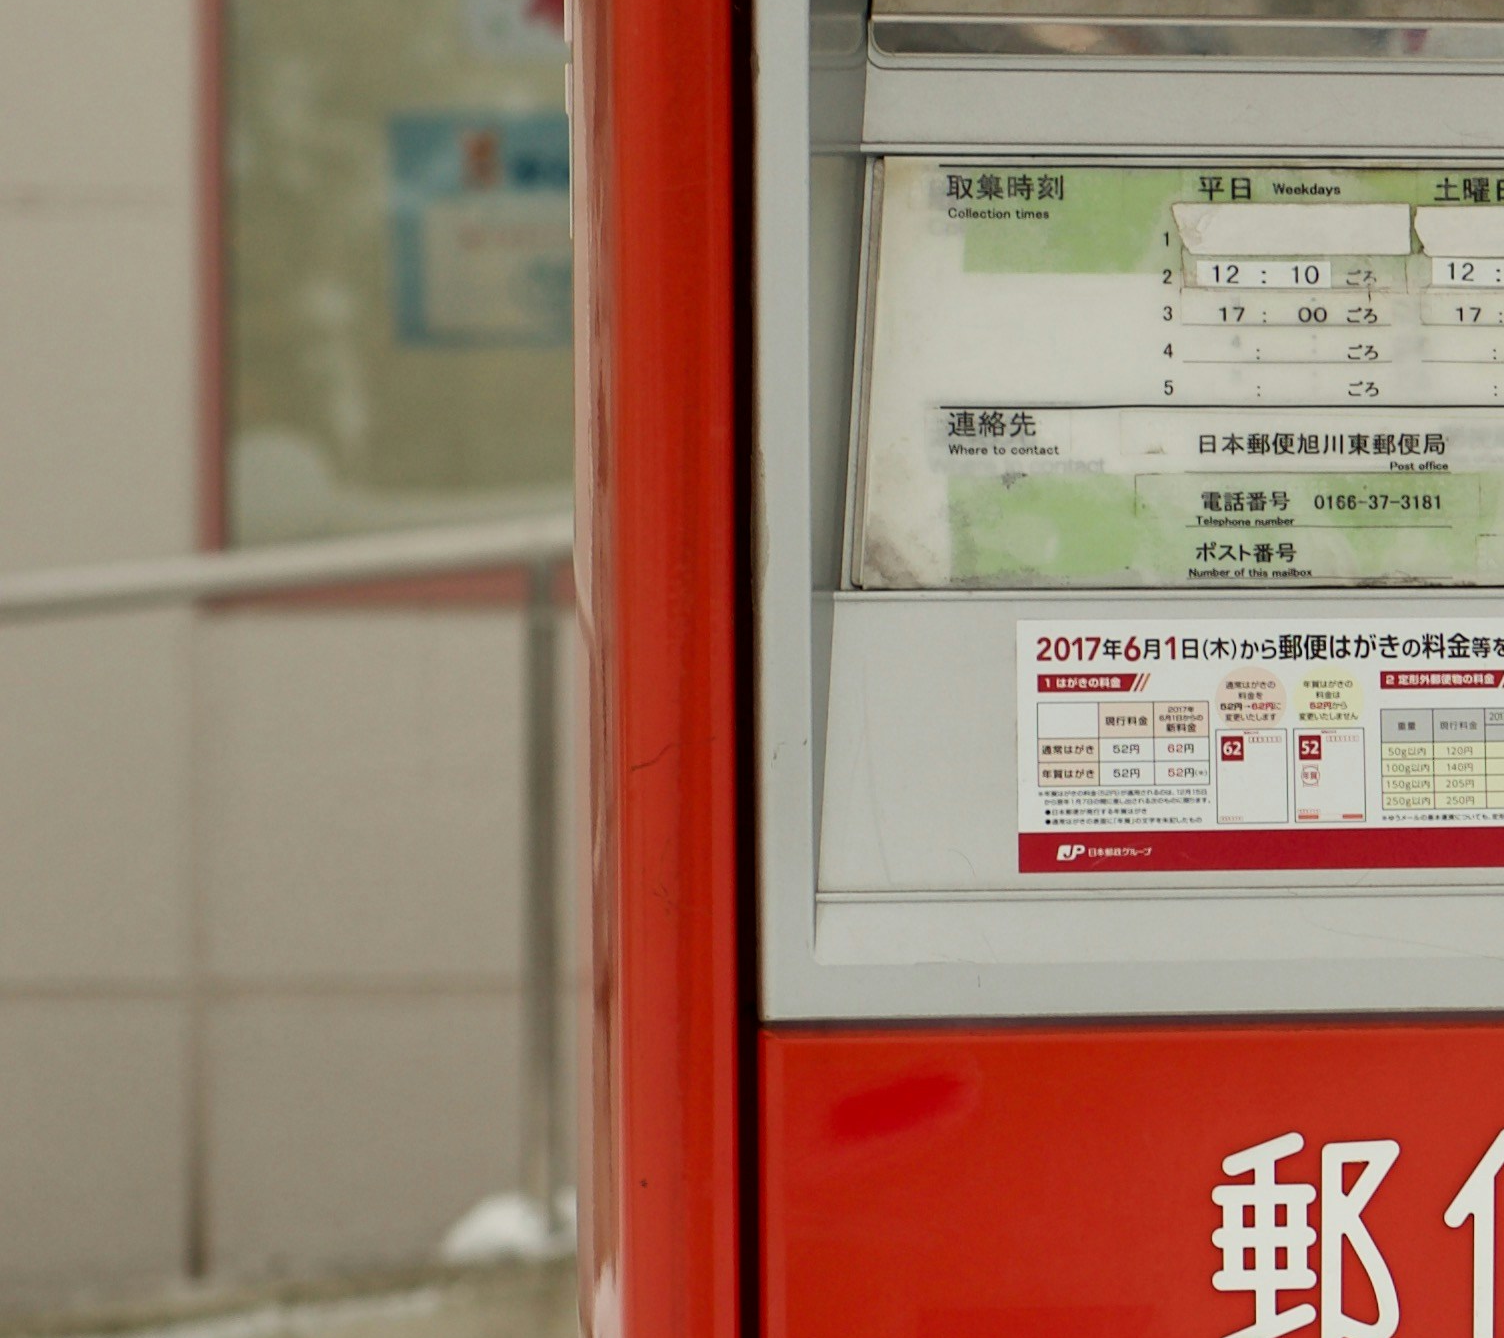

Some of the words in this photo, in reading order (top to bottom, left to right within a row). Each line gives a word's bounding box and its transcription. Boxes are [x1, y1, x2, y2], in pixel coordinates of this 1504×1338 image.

[946, 174, 1065, 201] 取集時刻
[1198, 176, 1251, 201] 平日
[1273, 182, 1341, 196] Weekdays
[948, 207, 1011, 219] Collection
[1015, 207, 1049, 219] times
[1163, 232, 1170, 246] 1
[1163, 269, 1173, 284] 2
[1163, 306, 1173, 321] 3
[1346, 306, 1378, 324] ごろ
[1163, 343, 1173, 358] 4
[1347, 344, 1379, 360] ごろ
[1164, 380, 1174, 396] 5
[1348, 381, 1379, 397] ごろ
[948, 411, 1037, 437] 連絡先
[948, 444, 988, 455] Where
[993, 445, 1006, 455] to
[1011, 445, 1060, 455] contact
[1199, 433, 1446, 456] 日本郵便旭川東郵便局
[1390, 461, 1414, 471] Post
[1418, 461, 1449, 471] office
[1201, 491, 1290, 512] 電話番号
[1314, 495, 1442, 511] 0166-37-3181
[1196, 515, 1251, 527] Telephone
[1255, 516, 1295, 527] number
[1196, 542, 1297, 563] ポスト番号
[1189, 567, 1230, 578] Number
[1234, 567, 1245, 578] of
[1248, 567, 1268, 578] this
[1272, 567, 1312, 578] mailbox
[1056, 676, 1122, 689] はがきの料金
[1398, 674, 1495, 686] 定形外郵便物の料金
[1105, 716, 1148, 726] 現行料金
[1166, 723, 1197, 733] 新料金
[1042, 744, 1095, 755] 通常はがき
[1112, 744, 1140, 754] 52円
[1167, 743, 1195, 754] 62円
[1223, 741, 1242, 756] 62
[1301, 740, 1320, 755] 52
[1042, 769, 1095, 779] 年賀はがき
[1113, 768, 1141, 778] 52円
